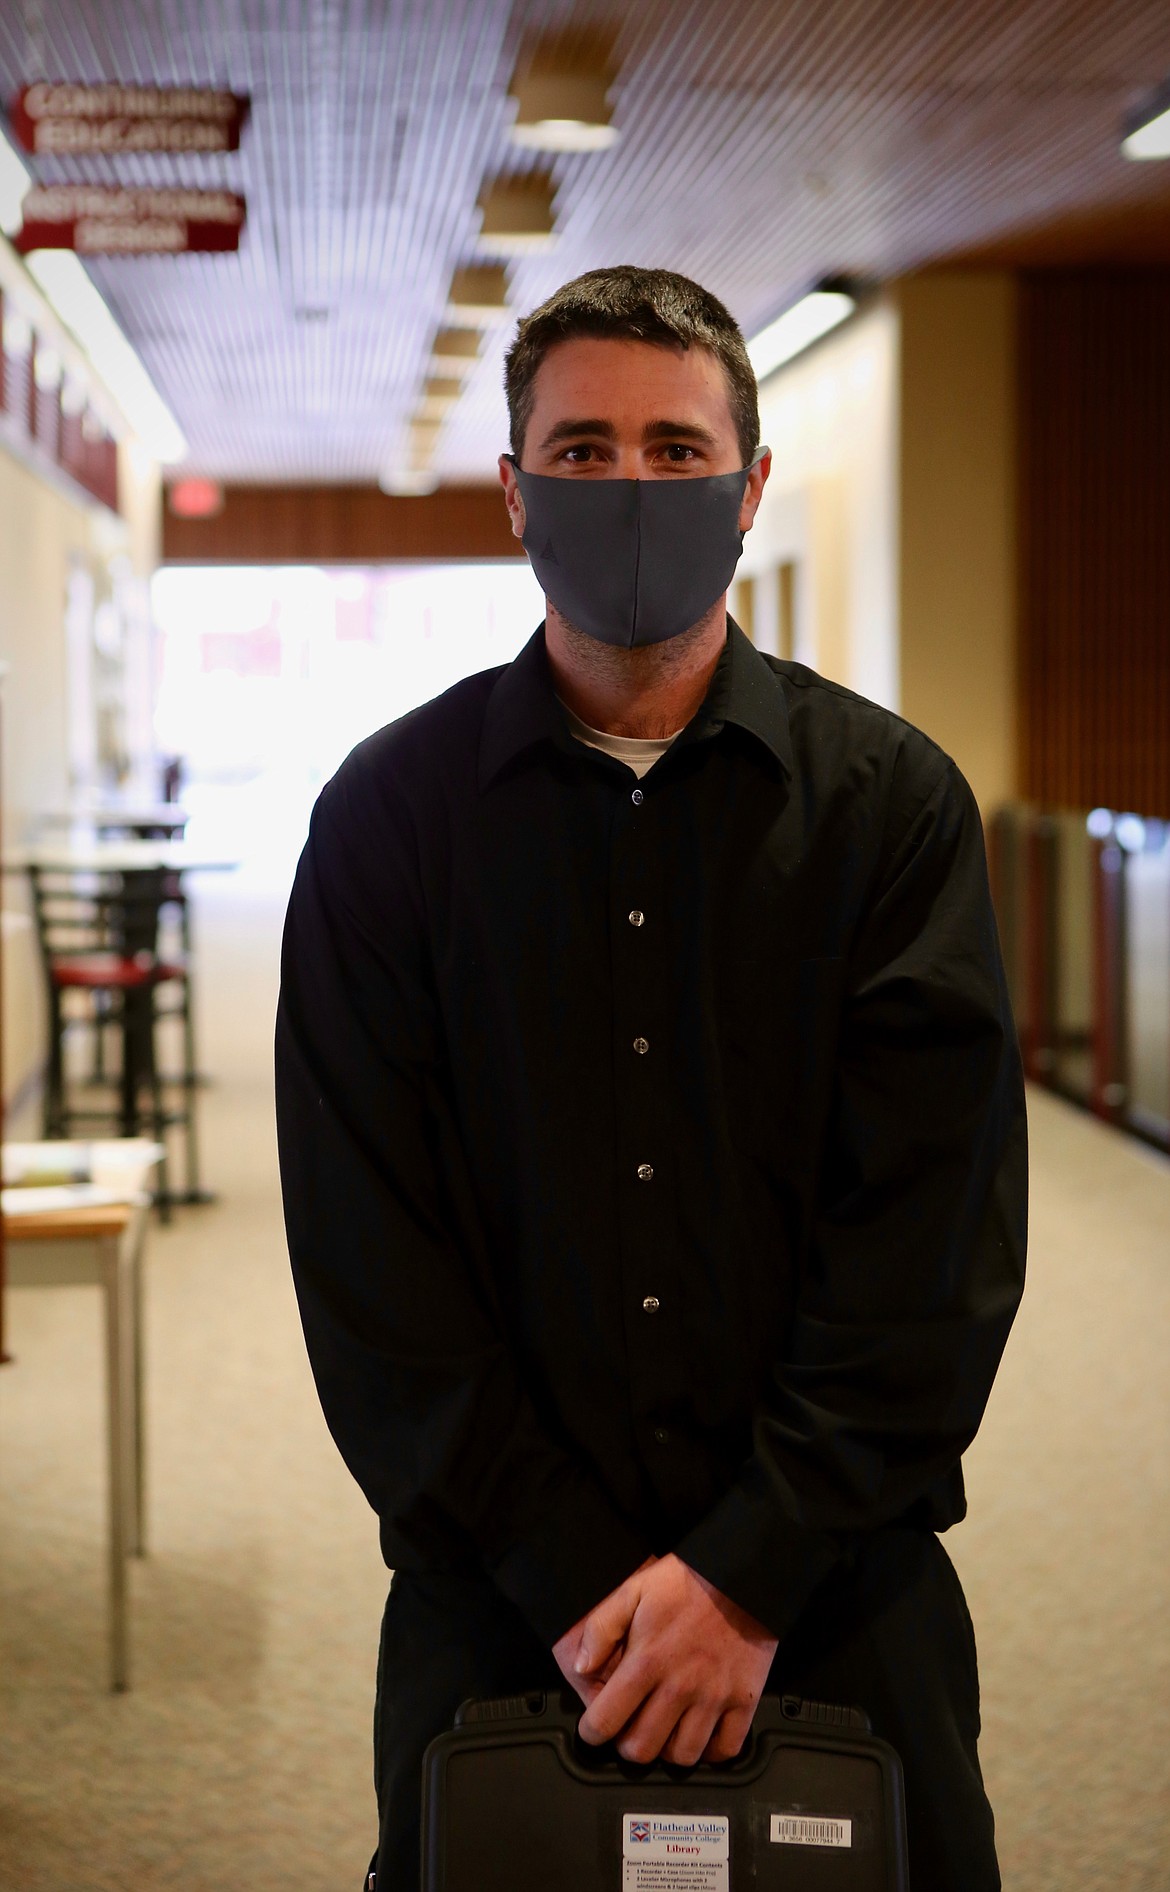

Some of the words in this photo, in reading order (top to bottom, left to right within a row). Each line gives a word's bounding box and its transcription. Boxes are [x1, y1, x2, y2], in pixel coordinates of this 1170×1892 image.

[653, 1822, 695, 1833] Flathead
[698, 1824, 727, 1835] Valley
[652, 1834, 693, 1843] Community
[695, 1835, 721, 1844] College
[666, 1844, 701, 1856] Library
